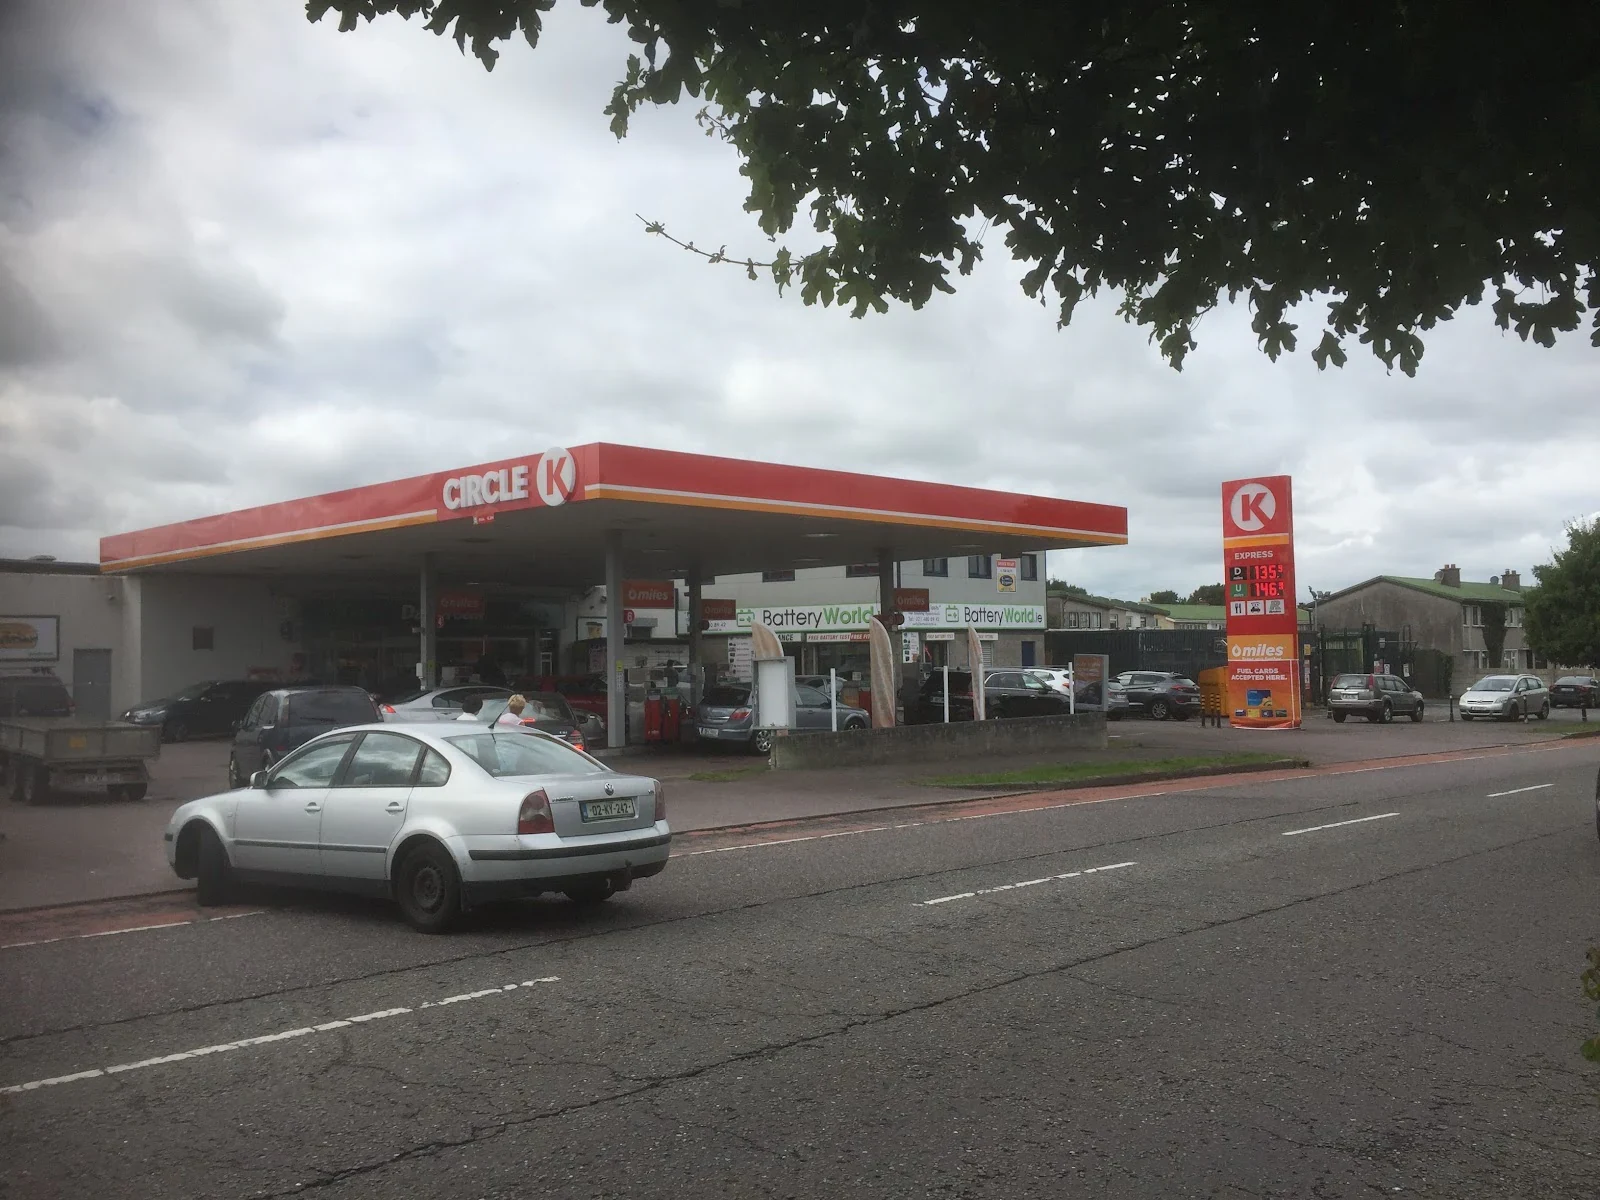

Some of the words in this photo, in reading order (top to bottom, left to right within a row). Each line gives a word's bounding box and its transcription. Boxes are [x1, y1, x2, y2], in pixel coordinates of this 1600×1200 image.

[443, 465, 528, 510] CIRCLE
[543, 452, 573, 505] K
[1237, 489, 1274, 527] K
[1234, 550, 1274, 560] EXPRESS
[1234, 567, 1242, 575] D
[1255, 564, 1283, 580] 135.9
[637, 588, 669, 601] miles
[1235, 583, 1242, 592] U
[626, 611, 633, 622] 6
[964, 606, 1043, 626] BatteryWorld.ie
[1242, 643, 1284, 657] miles
[592, 801, 629, 817] 02-KY-242
